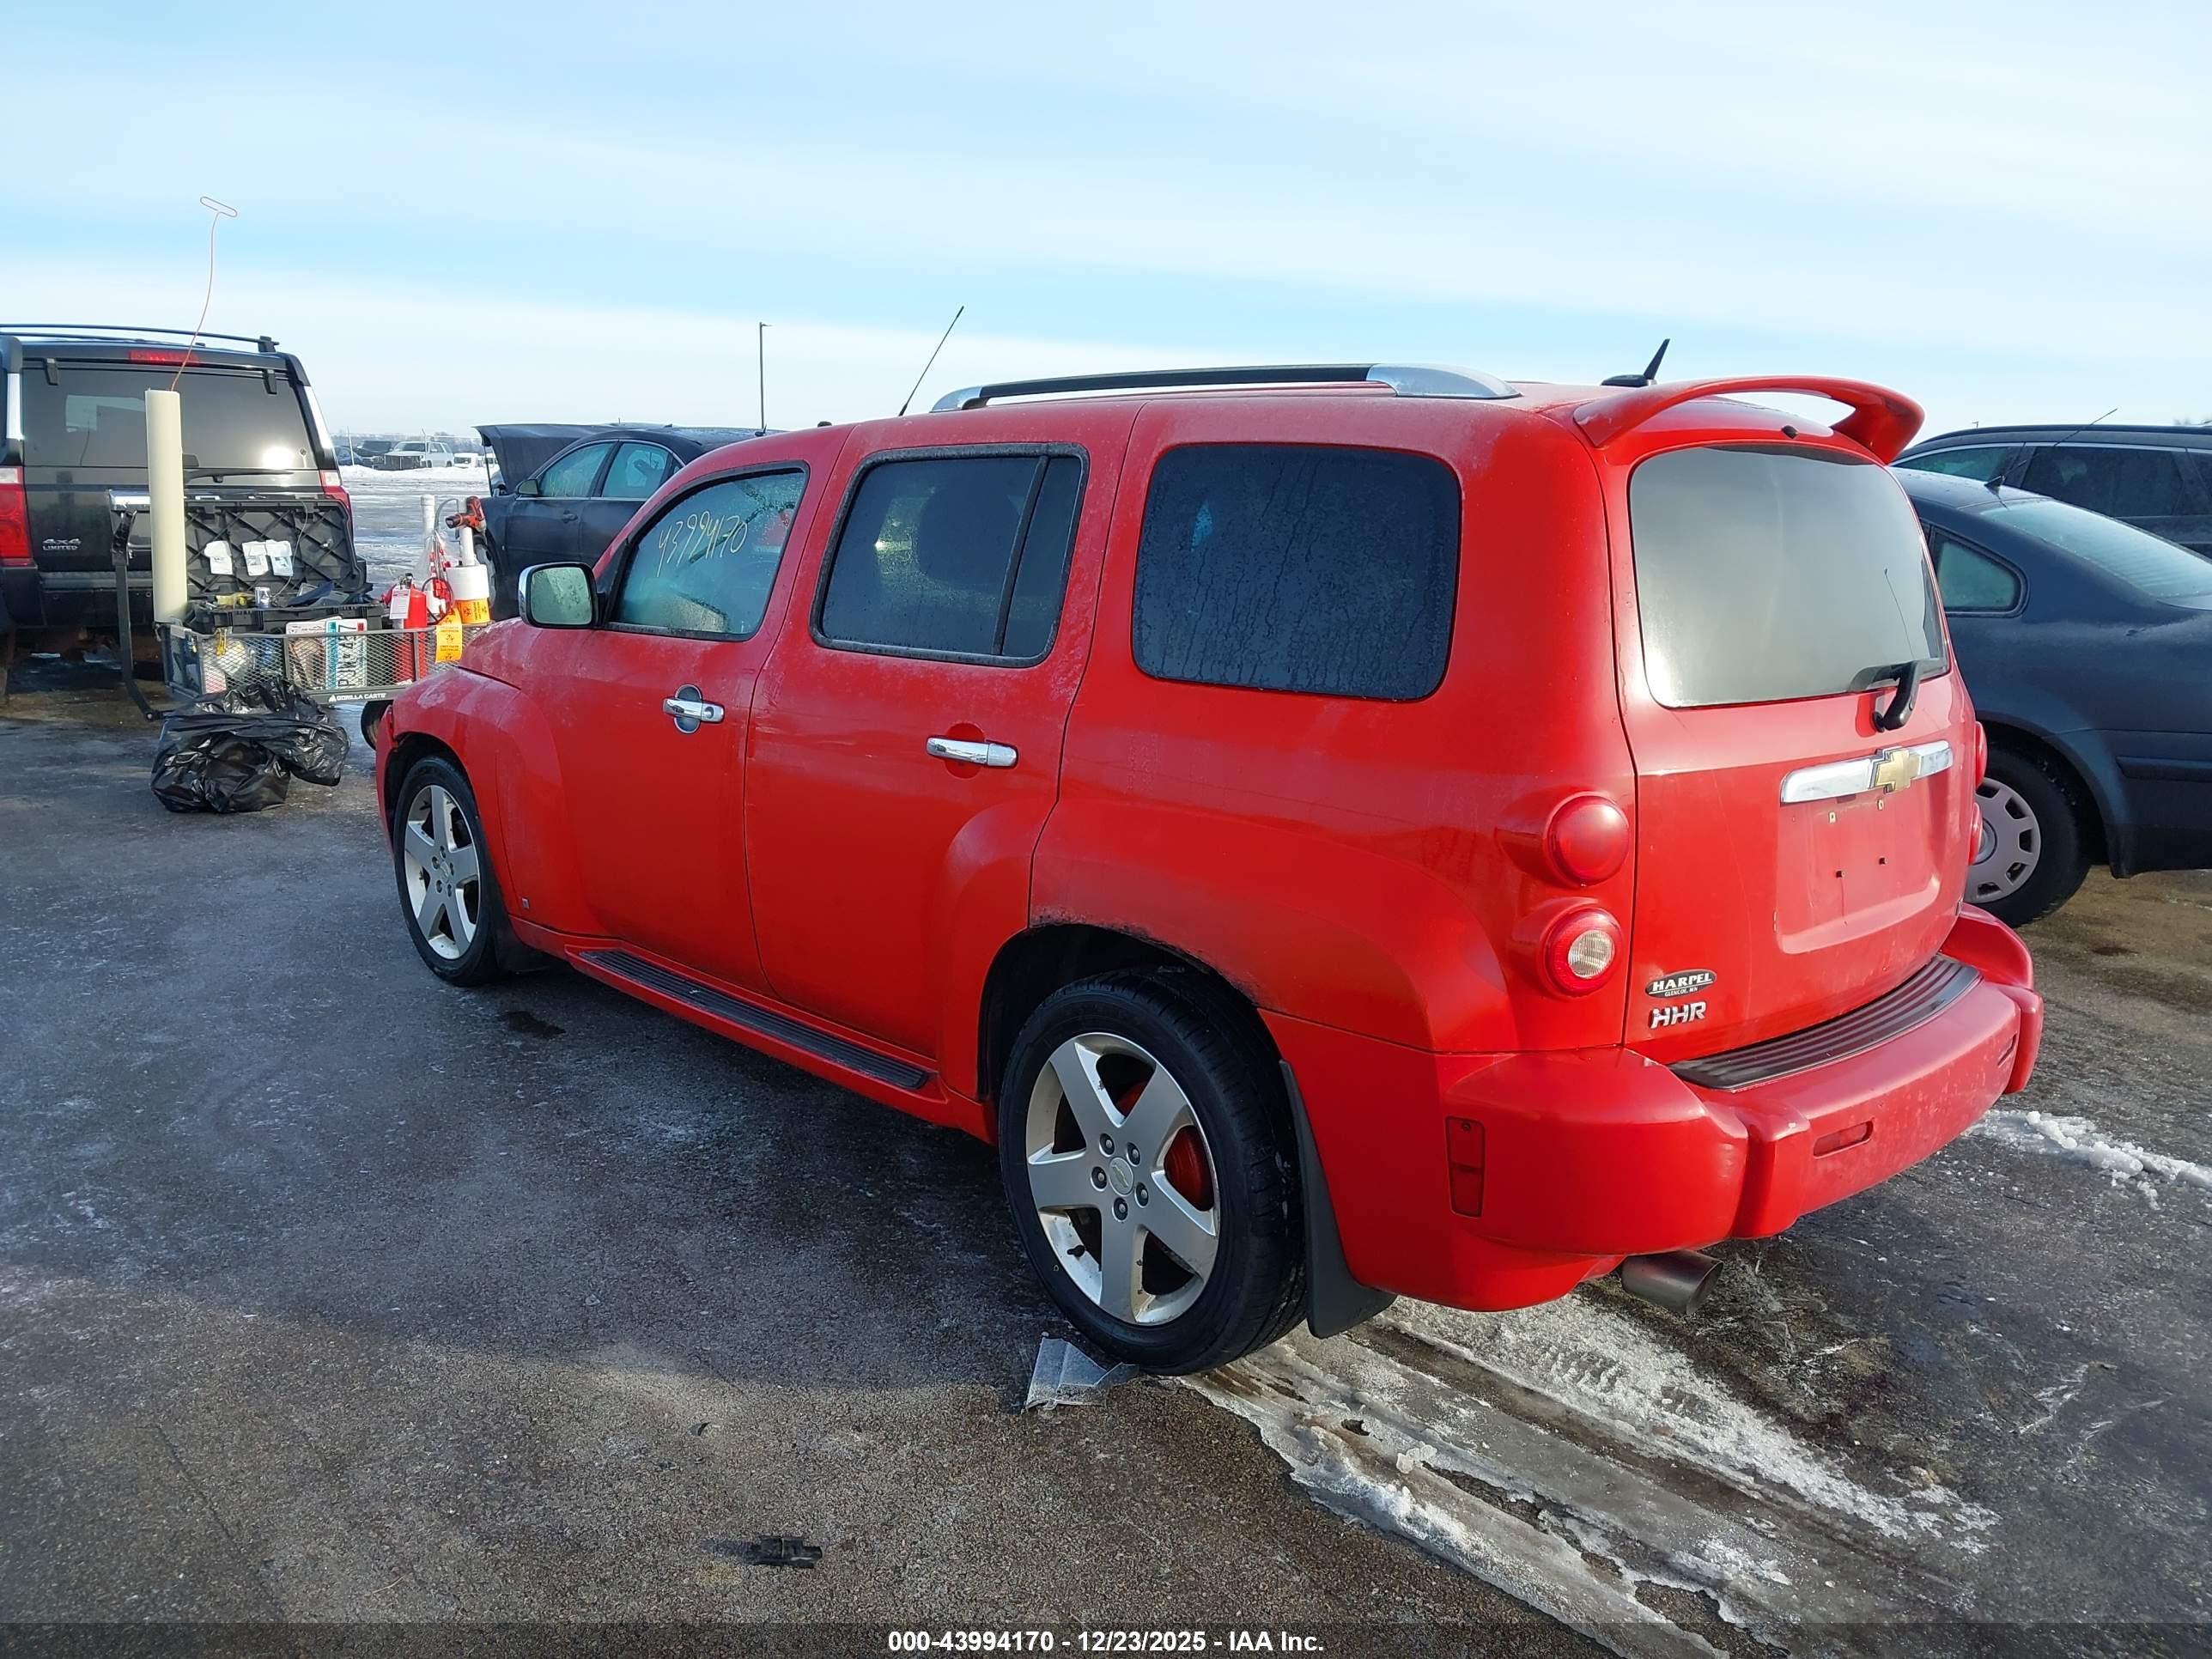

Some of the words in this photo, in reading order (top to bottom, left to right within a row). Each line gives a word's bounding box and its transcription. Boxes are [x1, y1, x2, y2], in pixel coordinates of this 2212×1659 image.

[657, 511, 748, 578] 43994170
[1652, 973, 1713, 992] HARPEL
[1650, 1001, 1706, 1029] HHR
